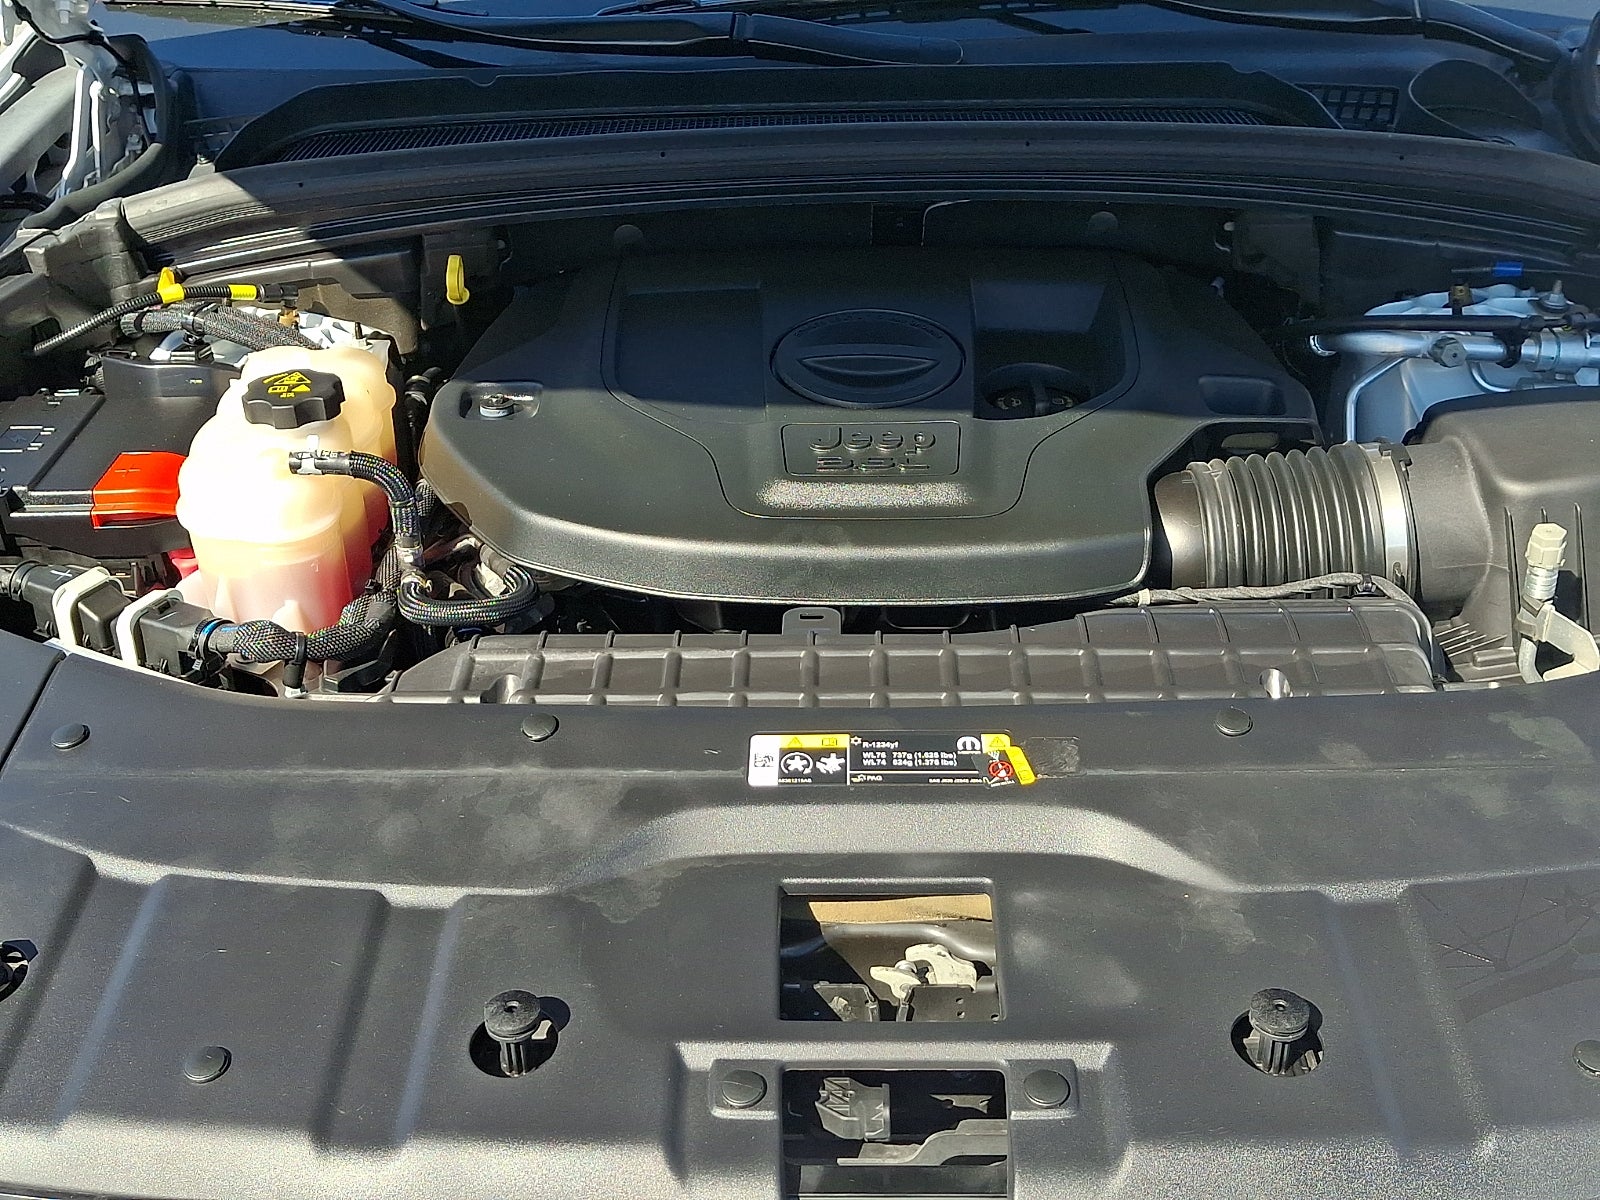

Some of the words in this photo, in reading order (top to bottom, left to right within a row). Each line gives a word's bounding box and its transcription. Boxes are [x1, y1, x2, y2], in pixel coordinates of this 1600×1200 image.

[809, 426, 936, 455] Jeep
[862, 741, 899, 750] R-1234yf
[940, 751, 957, 760] lbs)
[941, 759, 958, 767] lbs)
